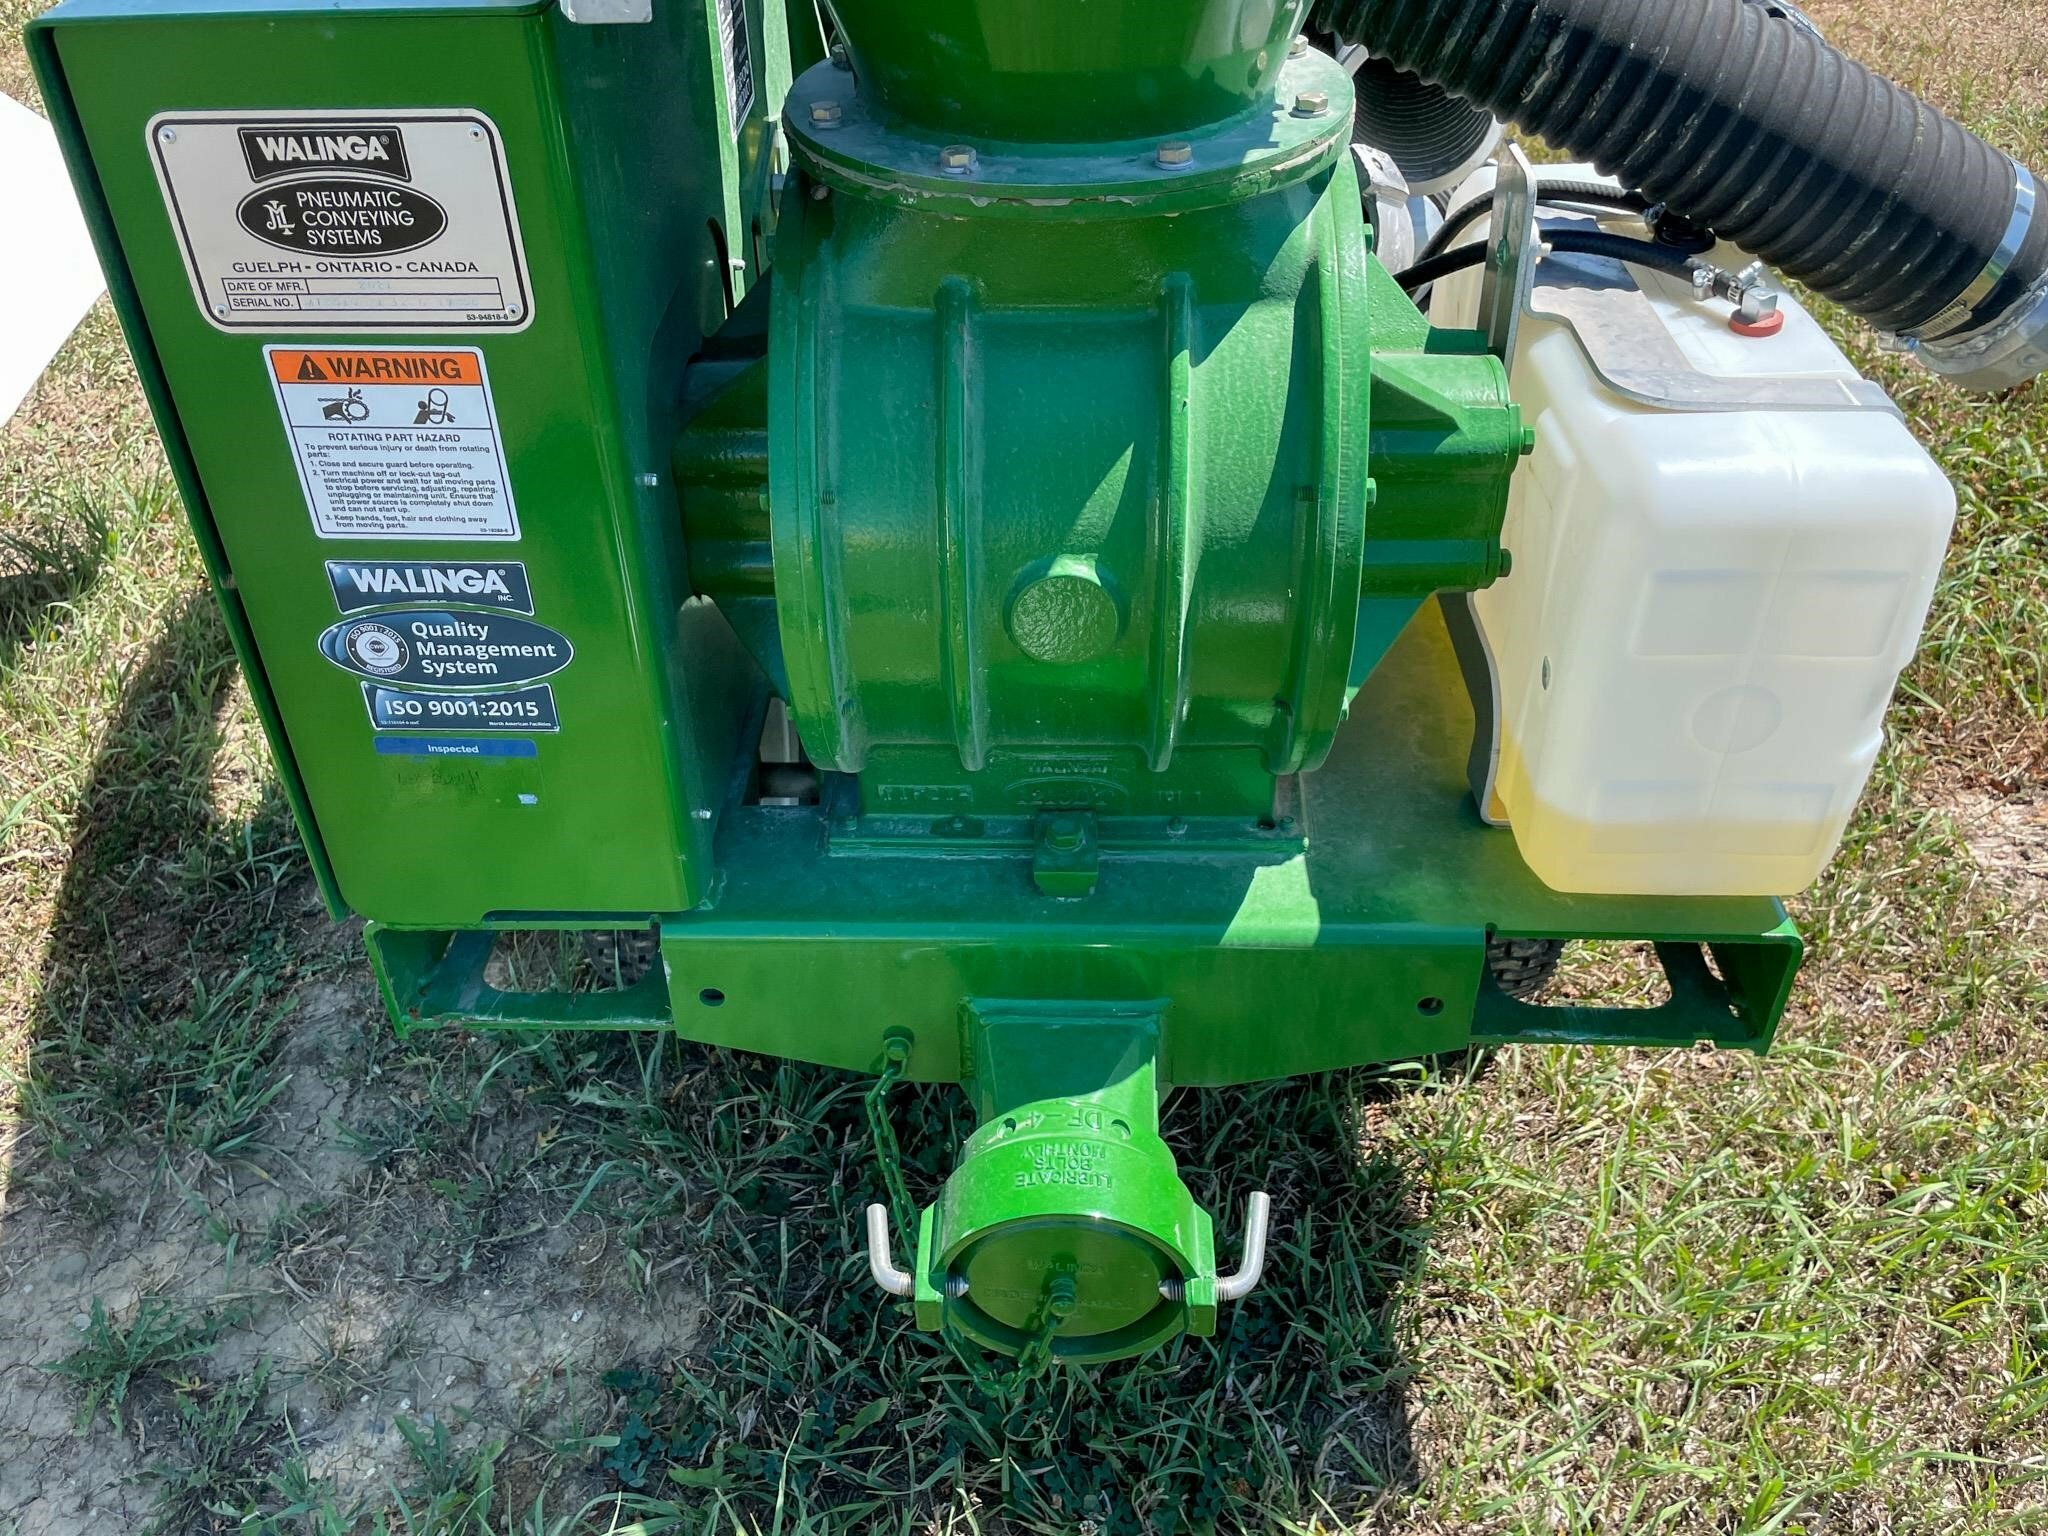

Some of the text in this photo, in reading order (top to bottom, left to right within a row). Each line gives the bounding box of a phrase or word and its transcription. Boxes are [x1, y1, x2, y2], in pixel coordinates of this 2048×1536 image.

[296, 192, 402, 207] PNEUMATIC
[302, 211, 414, 226] CONVEYING
[306, 230, 382, 245] SYSTEMS
[232, 262, 302, 273] GUELPH
[316, 262, 392, 273] ONTARIO
[406, 262, 479, 273] CANADA
[228, 282, 304, 292] DATE OF MFR.
[232, 298, 271, 308] SERIAL
[274, 298, 294, 308] NO.
[327, 357, 461, 379] WARNING
[328, 433, 461, 442] ROTATING PART HAZARD
[350, 629, 360, 640] ISO
[411, 622, 489, 641] Quality
[416, 641, 557, 660] Management
[422, 660, 498, 677] System
[385, 700, 539, 716] ISO 9001:2015
[428, 745, 479, 754] Inspected
[1023, 1143, 1105, 1159] MONTHLY
[1035, 1156, 1092, 1170] BOLTS
[1015, 1172, 1112, 1189] LUBRICATE
